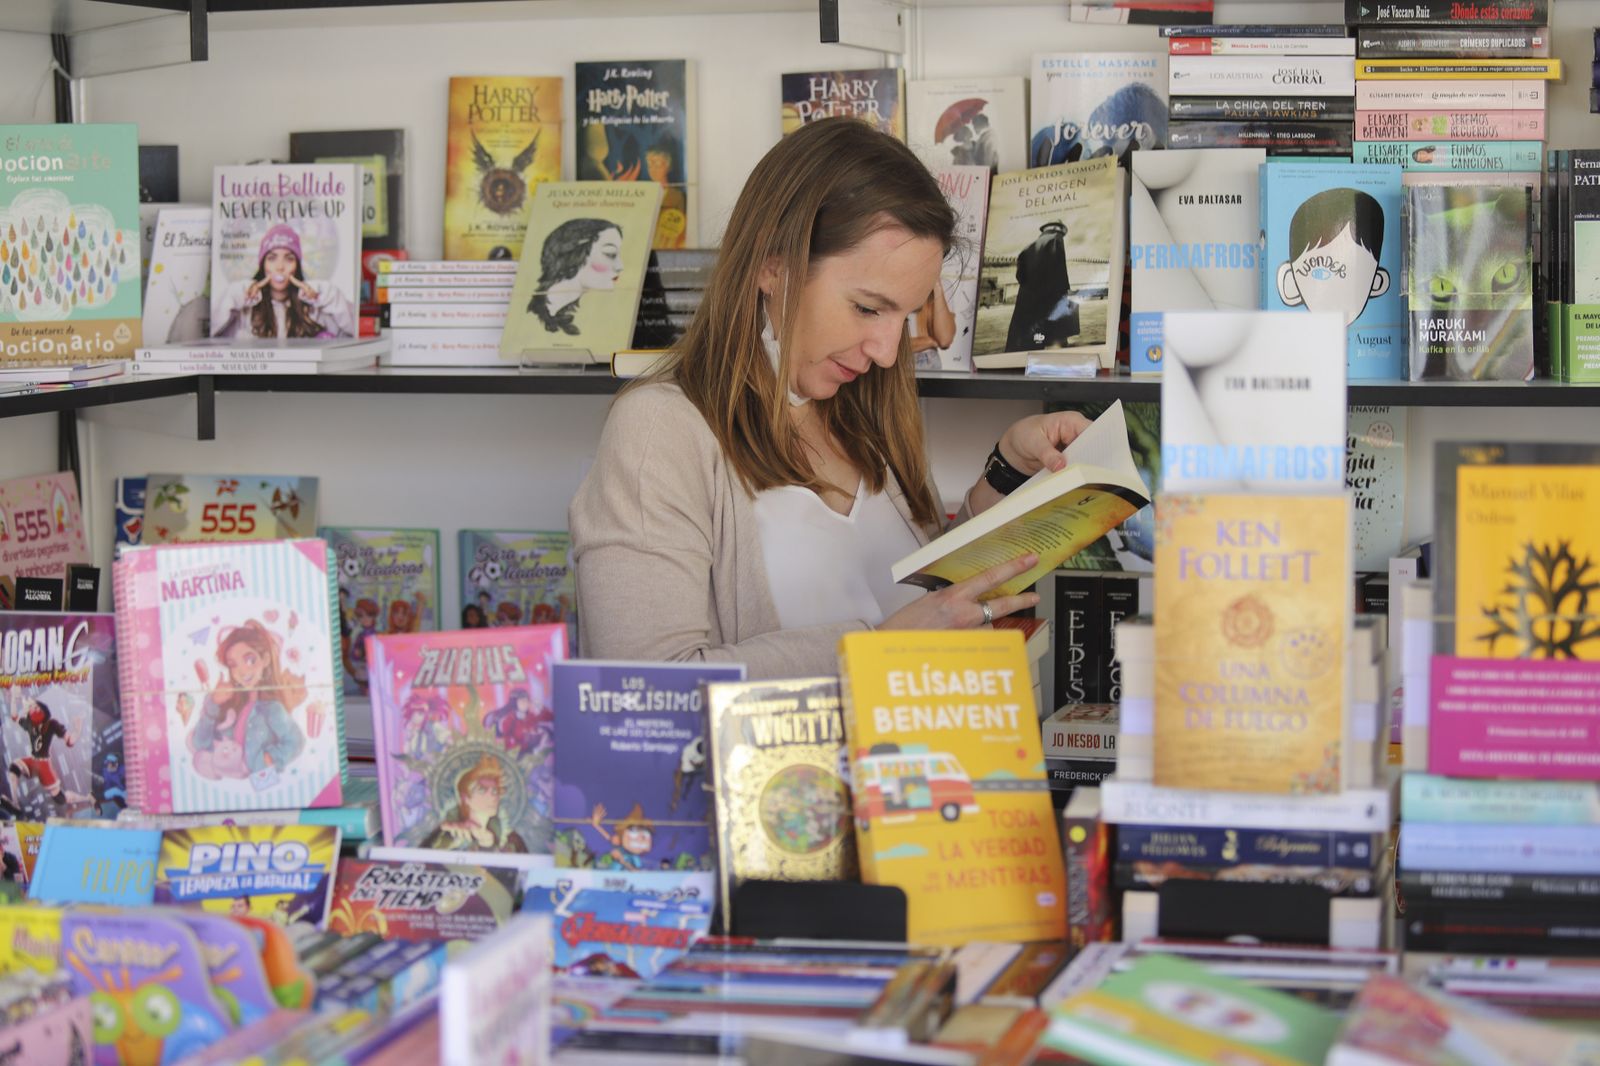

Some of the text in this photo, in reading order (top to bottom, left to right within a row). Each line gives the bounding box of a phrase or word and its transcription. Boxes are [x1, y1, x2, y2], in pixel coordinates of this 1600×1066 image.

[1377, 5, 1430, 21] José Vaccaro Ruiz
[1450, 3, 1534, 20] ¿Dónde estás corazón?
[1460, 38, 1526, 49] CRÍMENES DUPLICADOS
[1042, 59, 1158, 68] ESTELLE MASKAME
[1278, 68, 1297, 77] JOSÉ
[809, 77, 879, 102] HARRY
[1272, 75, 1326, 85] CORRAL
[473, 85, 540, 106] HARRY
[586, 84, 670, 114] Harry Potter
[468, 104, 542, 125] POTTER
[795, 100, 888, 127] POTTER
[1215, 102, 1326, 110] LA CHICA DEL TREN
[1225, 110, 1318, 118] PAULA HAWKINS
[1450, 113, 1488, 126] SEREMOS
[1054, 119, 1152, 147] forever
[1362, 126, 1409, 139] BENAVENT
[1450, 126, 1498, 138] RECUERDOS
[1451, 143, 1486, 156] FUIMOS
[1025, 169, 1064, 182] CARLOS
[1066, 162, 1109, 176] SOMOZA
[1451, 157, 1504, 169] CANCIONES
[277, 171, 346, 198] Bellido
[547, 189, 576, 198] JUAN
[1018, 178, 1087, 198] EL ORIGEN
[1025, 193, 1078, 210] DEL MAL
[1178, 195, 1242, 205] EVA BALTASAR
[220, 200, 346, 223] NEVER GIVE UP
[162, 233, 175, 249] El
[1419, 318, 1466, 330] HARUKI
[1355, 334, 1392, 348] August
[1419, 329, 1487, 342] MURAKAMI
[1419, 345, 1443, 354] Kafka
[1457, 345, 1465, 353] la
[1467, 345, 1490, 353] orilla
[1251, 376, 1313, 393] BALTASAR
[1163, 443, 1345, 481] PERMAFROST
[13, 509, 52, 543] 555
[200, 503, 257, 536] 555
[1217, 520, 1281, 547] KEN
[476, 545, 516, 564] Sara
[1178, 547, 1321, 584] FOLLETT
[161, 570, 246, 602] MARTINA
[411, 644, 527, 688] RUBIUS
[1065, 610, 1085, 704] ELDES
[887, 662, 1015, 697] ELÍSABET
[1219, 661, 1272, 679] UNA
[621, 677, 646, 691] LOS
[1179, 684, 1312, 707] COLUMNA
[872, 704, 1023, 734] BENAVENT
[1184, 707, 1309, 732] DE FUEGO
[1052, 732, 1116, 750] JO NESBØ LA
[1054, 770, 1101, 781] FREDERICK
[987, 809, 1041, 829] TODA
[189, 840, 311, 875] PINO
[938, 836, 1046, 861] LA VERDAD
[947, 865, 1053, 890] MENTIRAS
